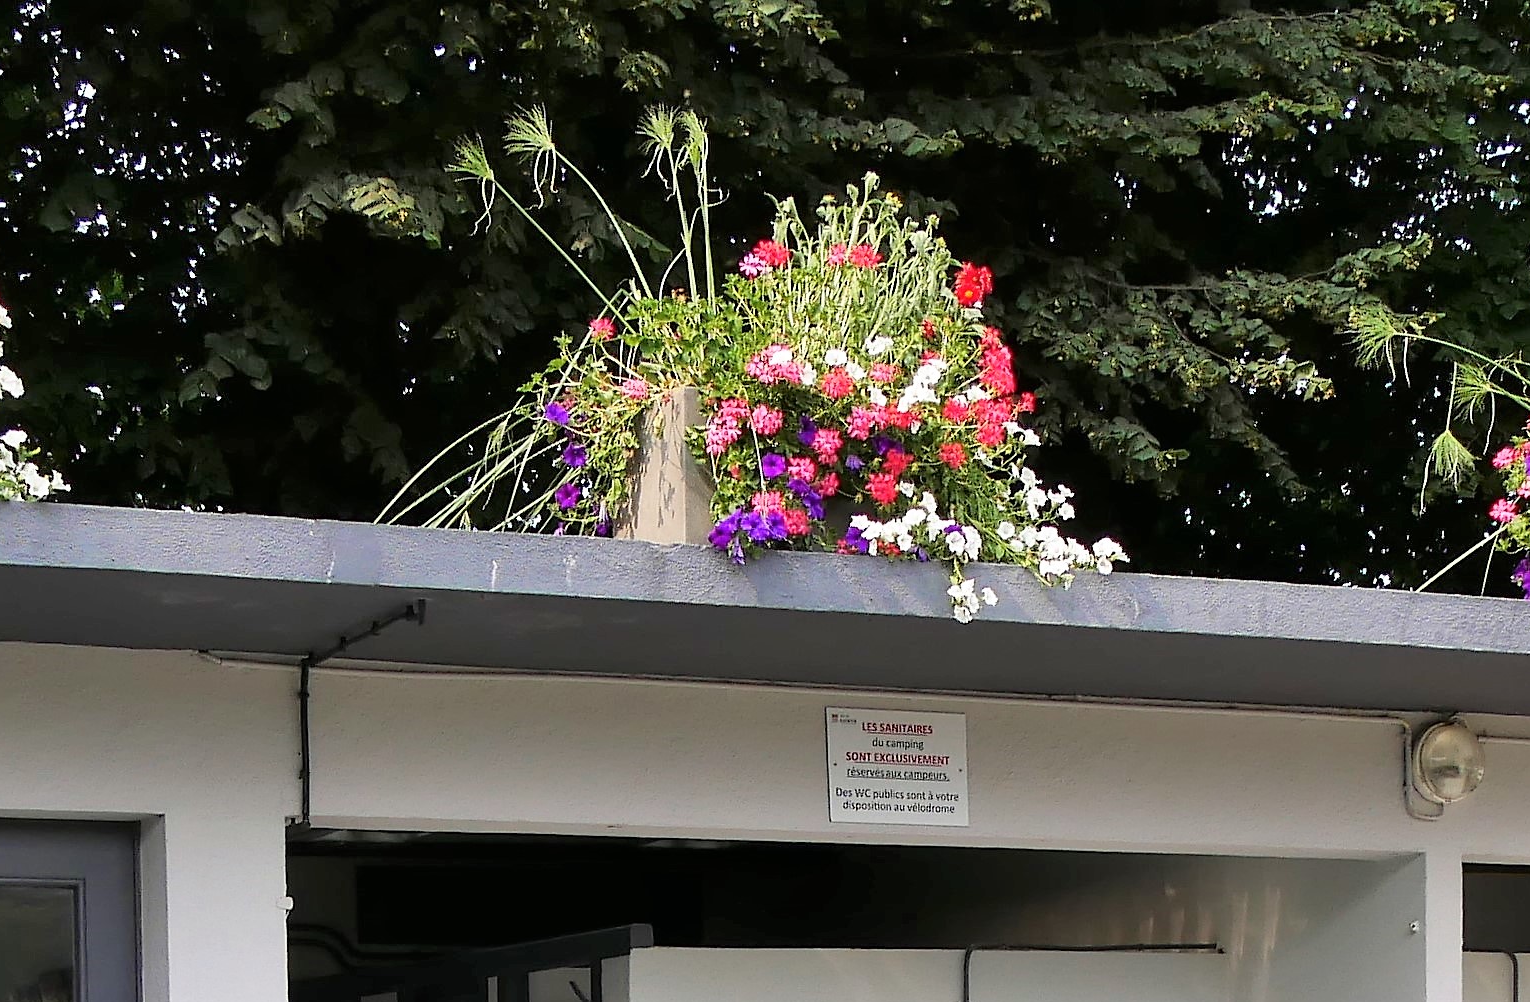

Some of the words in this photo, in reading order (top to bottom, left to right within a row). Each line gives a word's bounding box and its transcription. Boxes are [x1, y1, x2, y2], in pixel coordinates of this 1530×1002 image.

[862, 722, 877, 732] LES
[880, 723, 933, 735] SANITAIRES
[872, 738, 884, 747] du
[886, 740, 924, 751] camping
[846, 752, 871, 762] SONT
[874, 753, 950, 765] EXCLUSIVEMENT
[886, 770, 902, 779] aux
[836, 787, 852, 797] Des
[855, 788, 871, 798] WC
[873, 788, 904, 800] publics
[906, 791, 926, 800] sont
[935, 792, 959, 802] votre
[842, 801, 892, 812] disposition
[893, 804, 905, 812] au
[907, 803, 955, 814] vélodrome
